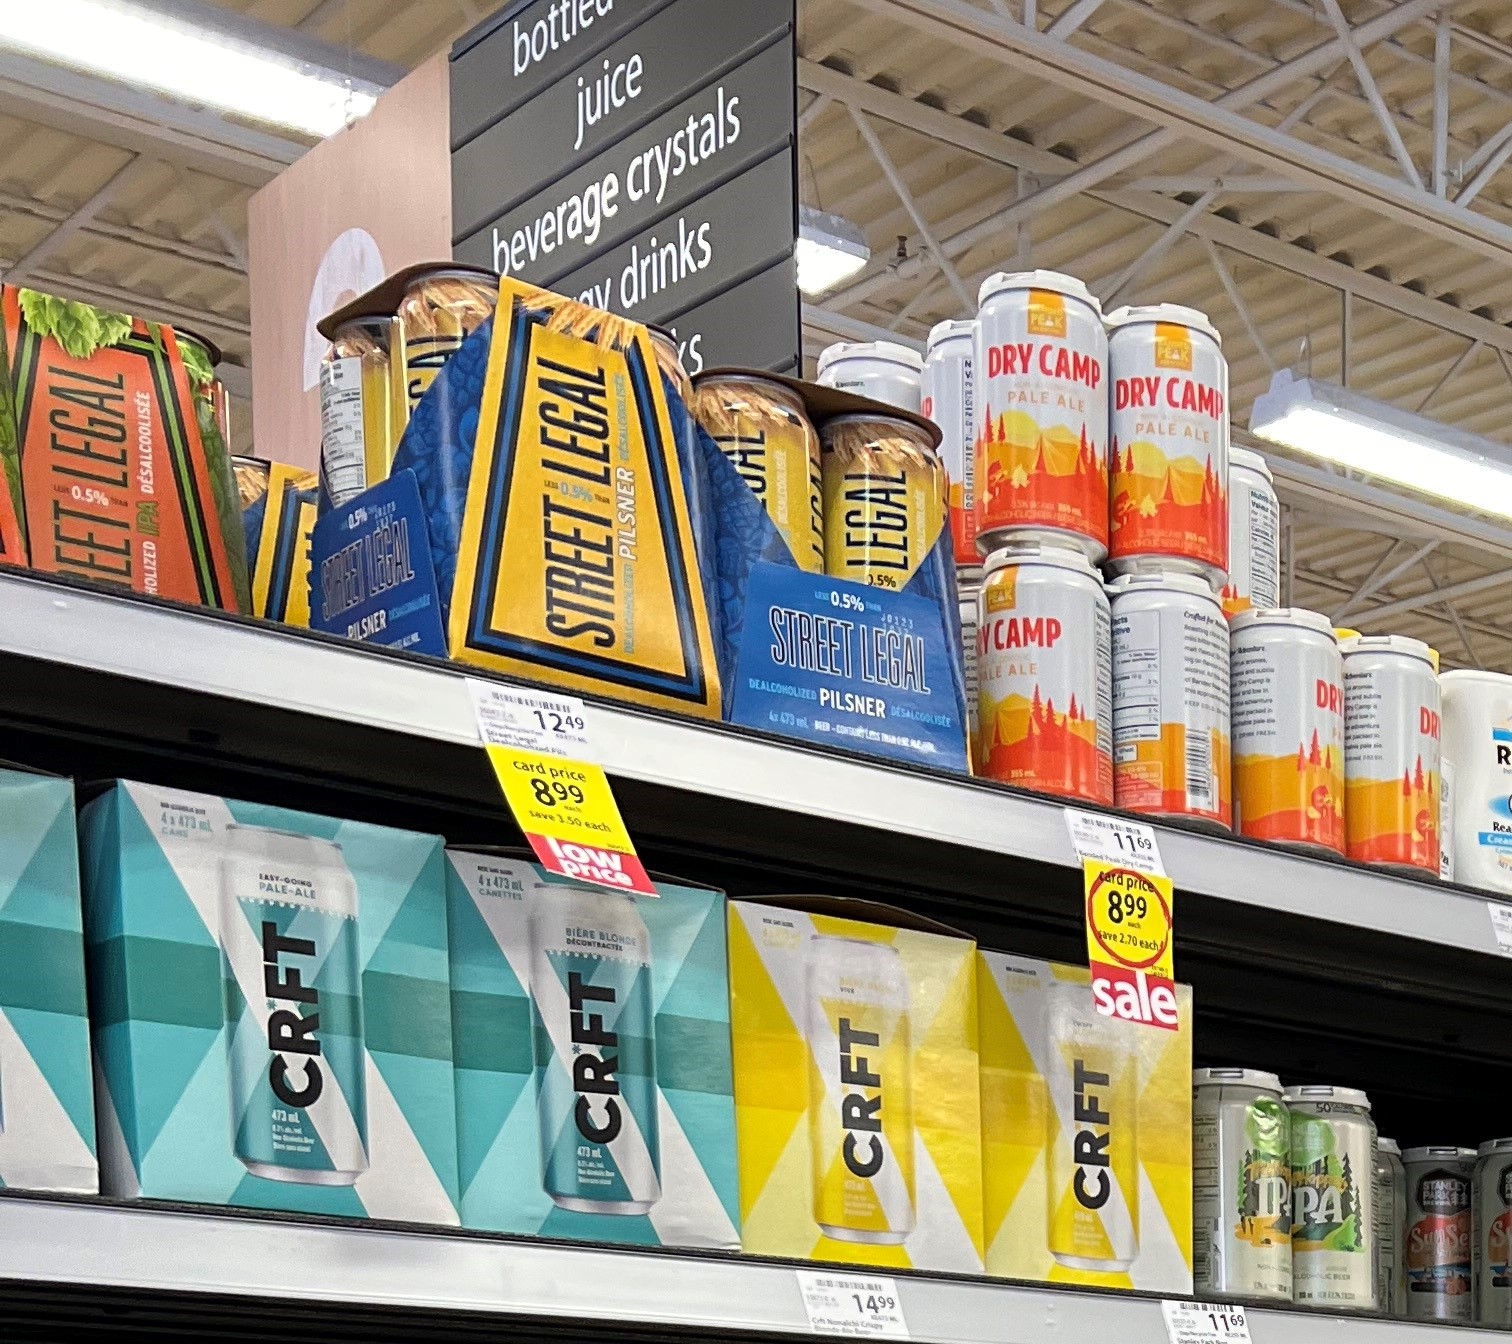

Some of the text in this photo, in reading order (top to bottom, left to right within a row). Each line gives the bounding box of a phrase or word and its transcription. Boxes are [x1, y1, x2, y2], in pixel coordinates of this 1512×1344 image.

[574, 53, 644, 151] juice
[491, 86, 742, 276] beverage crystals
[620, 217, 713, 309] drinks
[987, 342, 1035, 379] DRY
[1039, 344, 1102, 391] CAMP
[1007, 390, 1050, 406] PALE
[1115, 376, 1162, 412] DRY
[1166, 376, 1225, 421] CAMP
[48, 365, 130, 488] LEGAL
[139, 389, 156, 495] DÉSALCOOLISÉE
[537, 356, 610, 488] LEGAL
[1135, 422, 1177, 438] PALE
[71, 484, 109, 508] 0.5%
[616, 466, 637, 562] PILSNER
[845, 470, 910, 571] LEGAL
[543, 493, 617, 648] STREET
[830, 590, 865, 612] 0.5%
[768, 605, 933, 696] STREET LEGAL
[994, 616, 1062, 650] CAMP
[749, 677, 887, 719] DEALCOHOLIZED PILSNER
[1315, 679, 1343, 710] DRY
[512, 759, 545, 778] card
[258, 871, 314, 889] EASY-GOING
[261, 920, 325, 1110] CRFT
[1091, 970, 1179, 1026] sale
[567, 970, 624, 1146] CRFT
[837, 1018, 884, 1180] CRFT
[1071, 1059, 1111, 1211] CRFT
